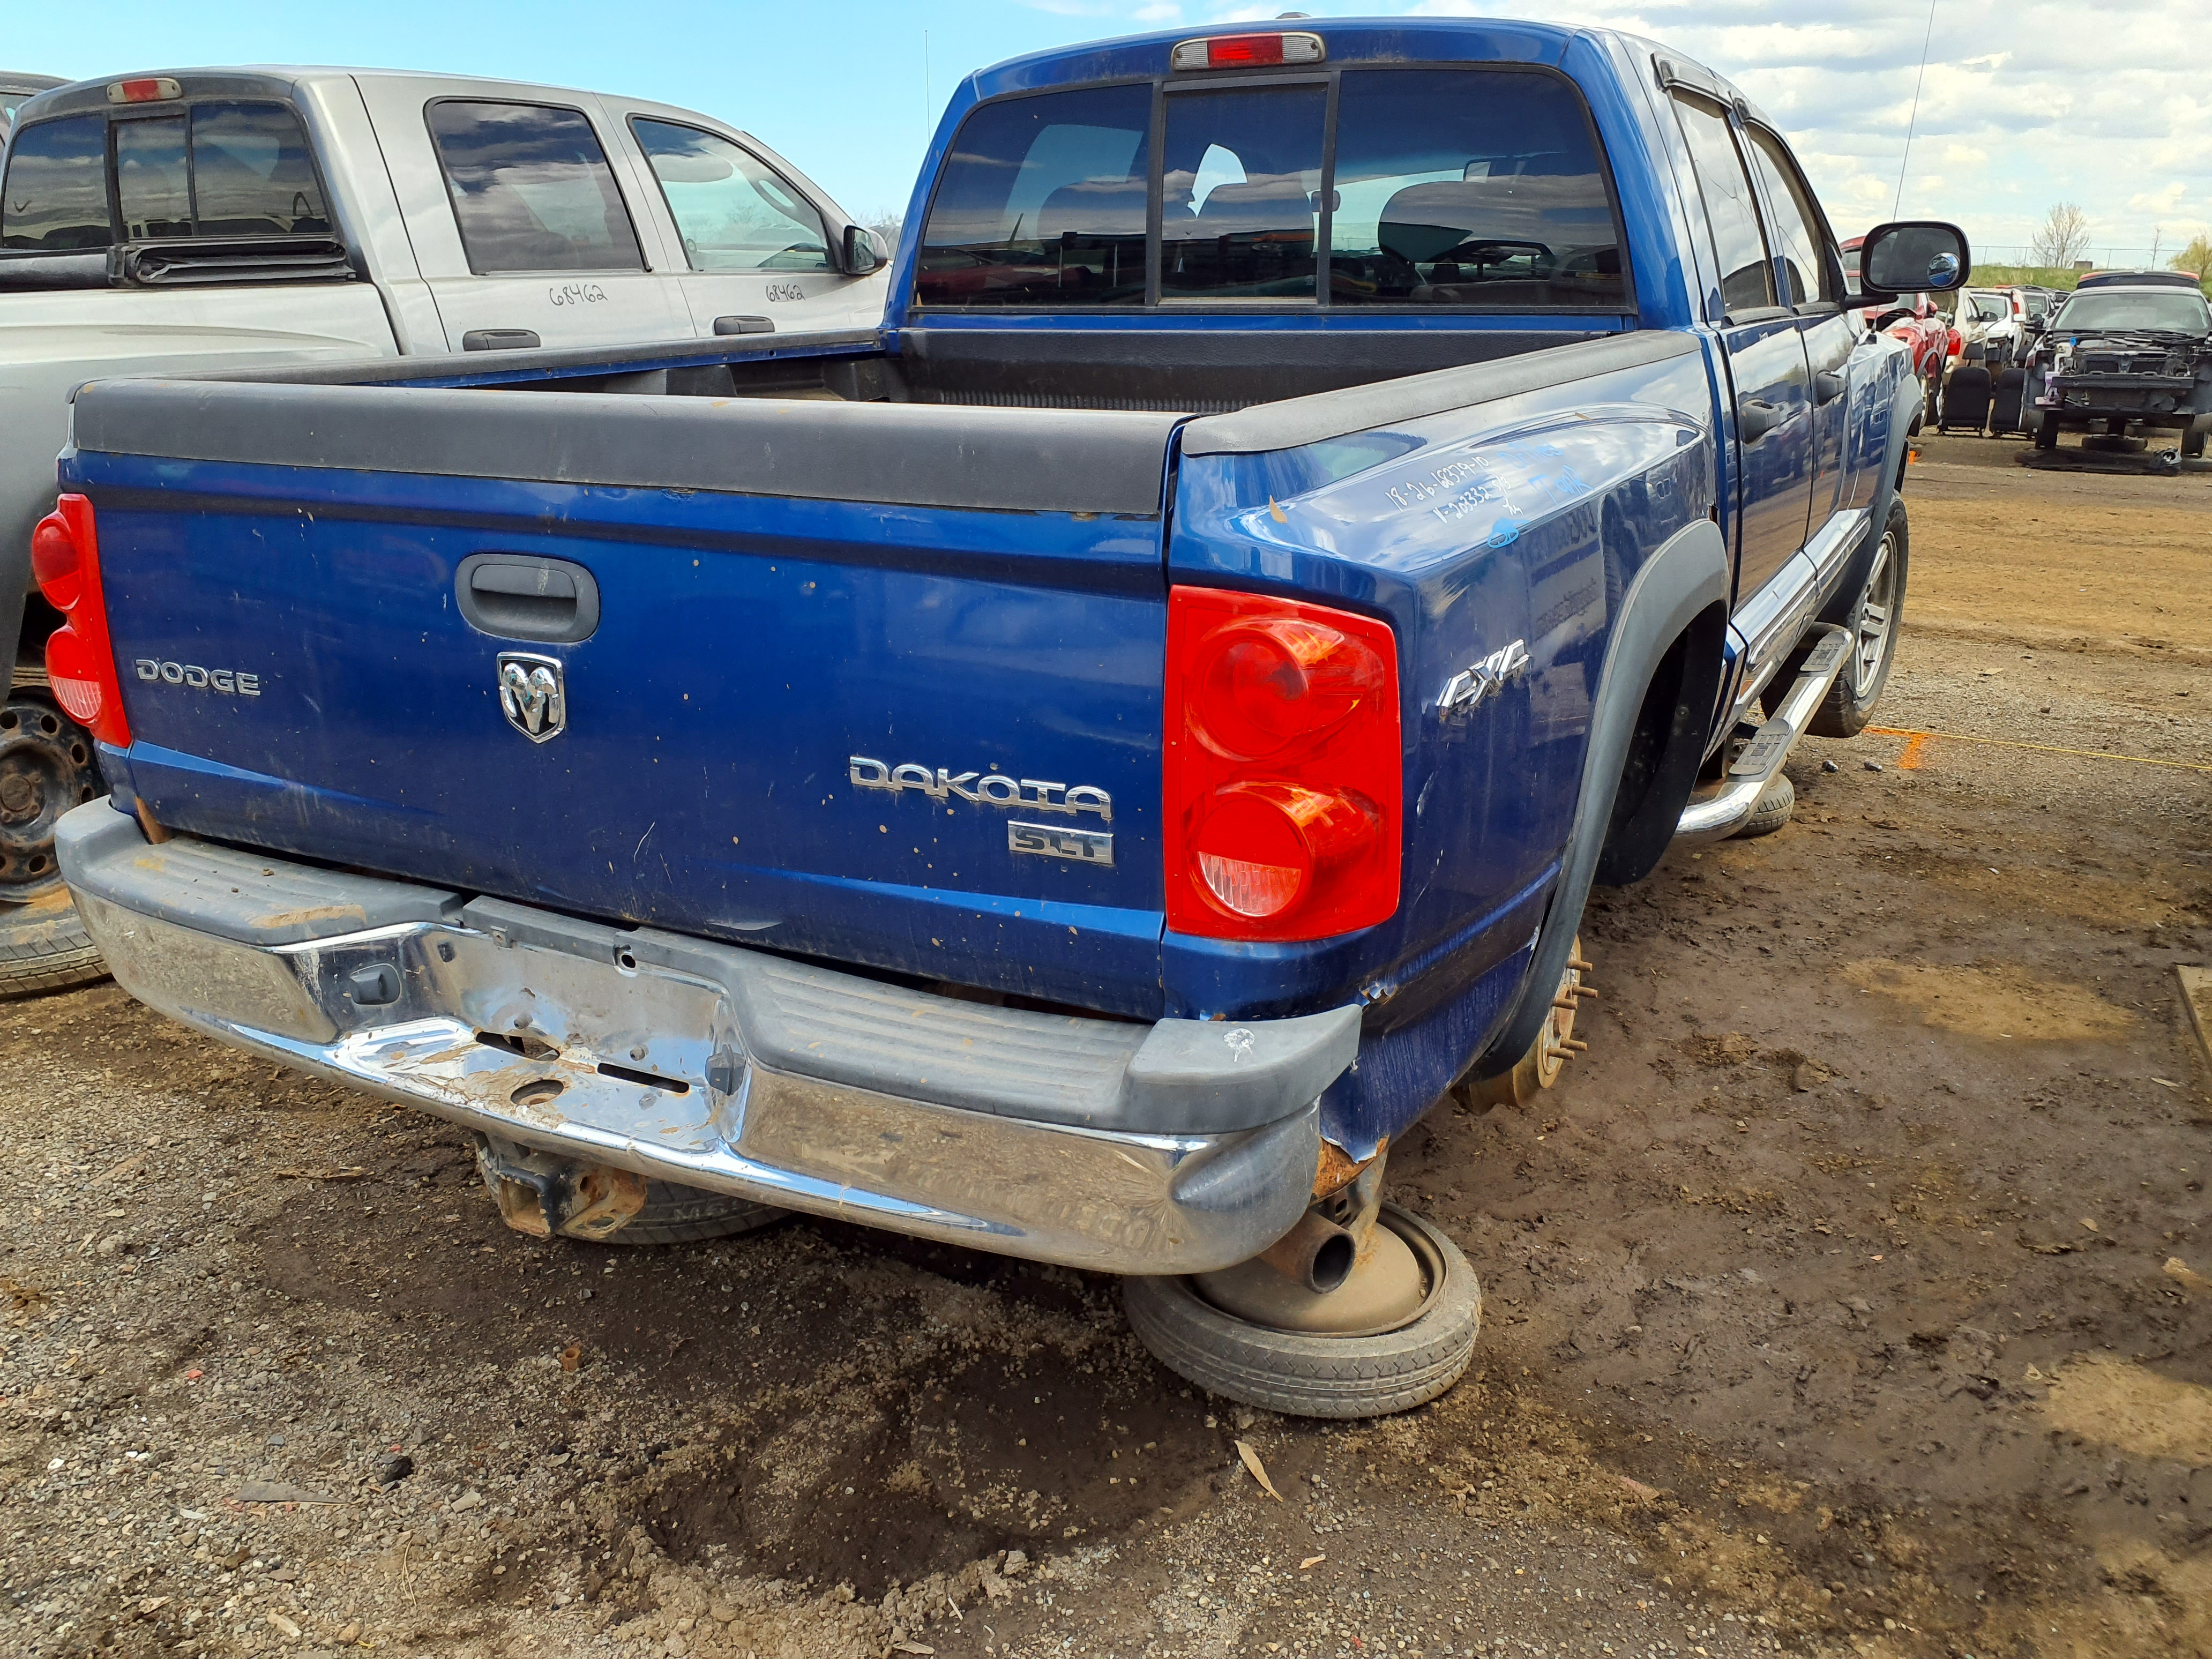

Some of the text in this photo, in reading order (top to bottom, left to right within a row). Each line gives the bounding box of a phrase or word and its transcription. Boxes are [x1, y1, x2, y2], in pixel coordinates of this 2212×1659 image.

[549, 284, 608, 306] 68462
[766, 283, 806, 302] 68462
[136, 659, 261, 697] DODGE
[849, 756, 1113, 820] DAKOTA
[1013, 827, 1107, 859] SLT
